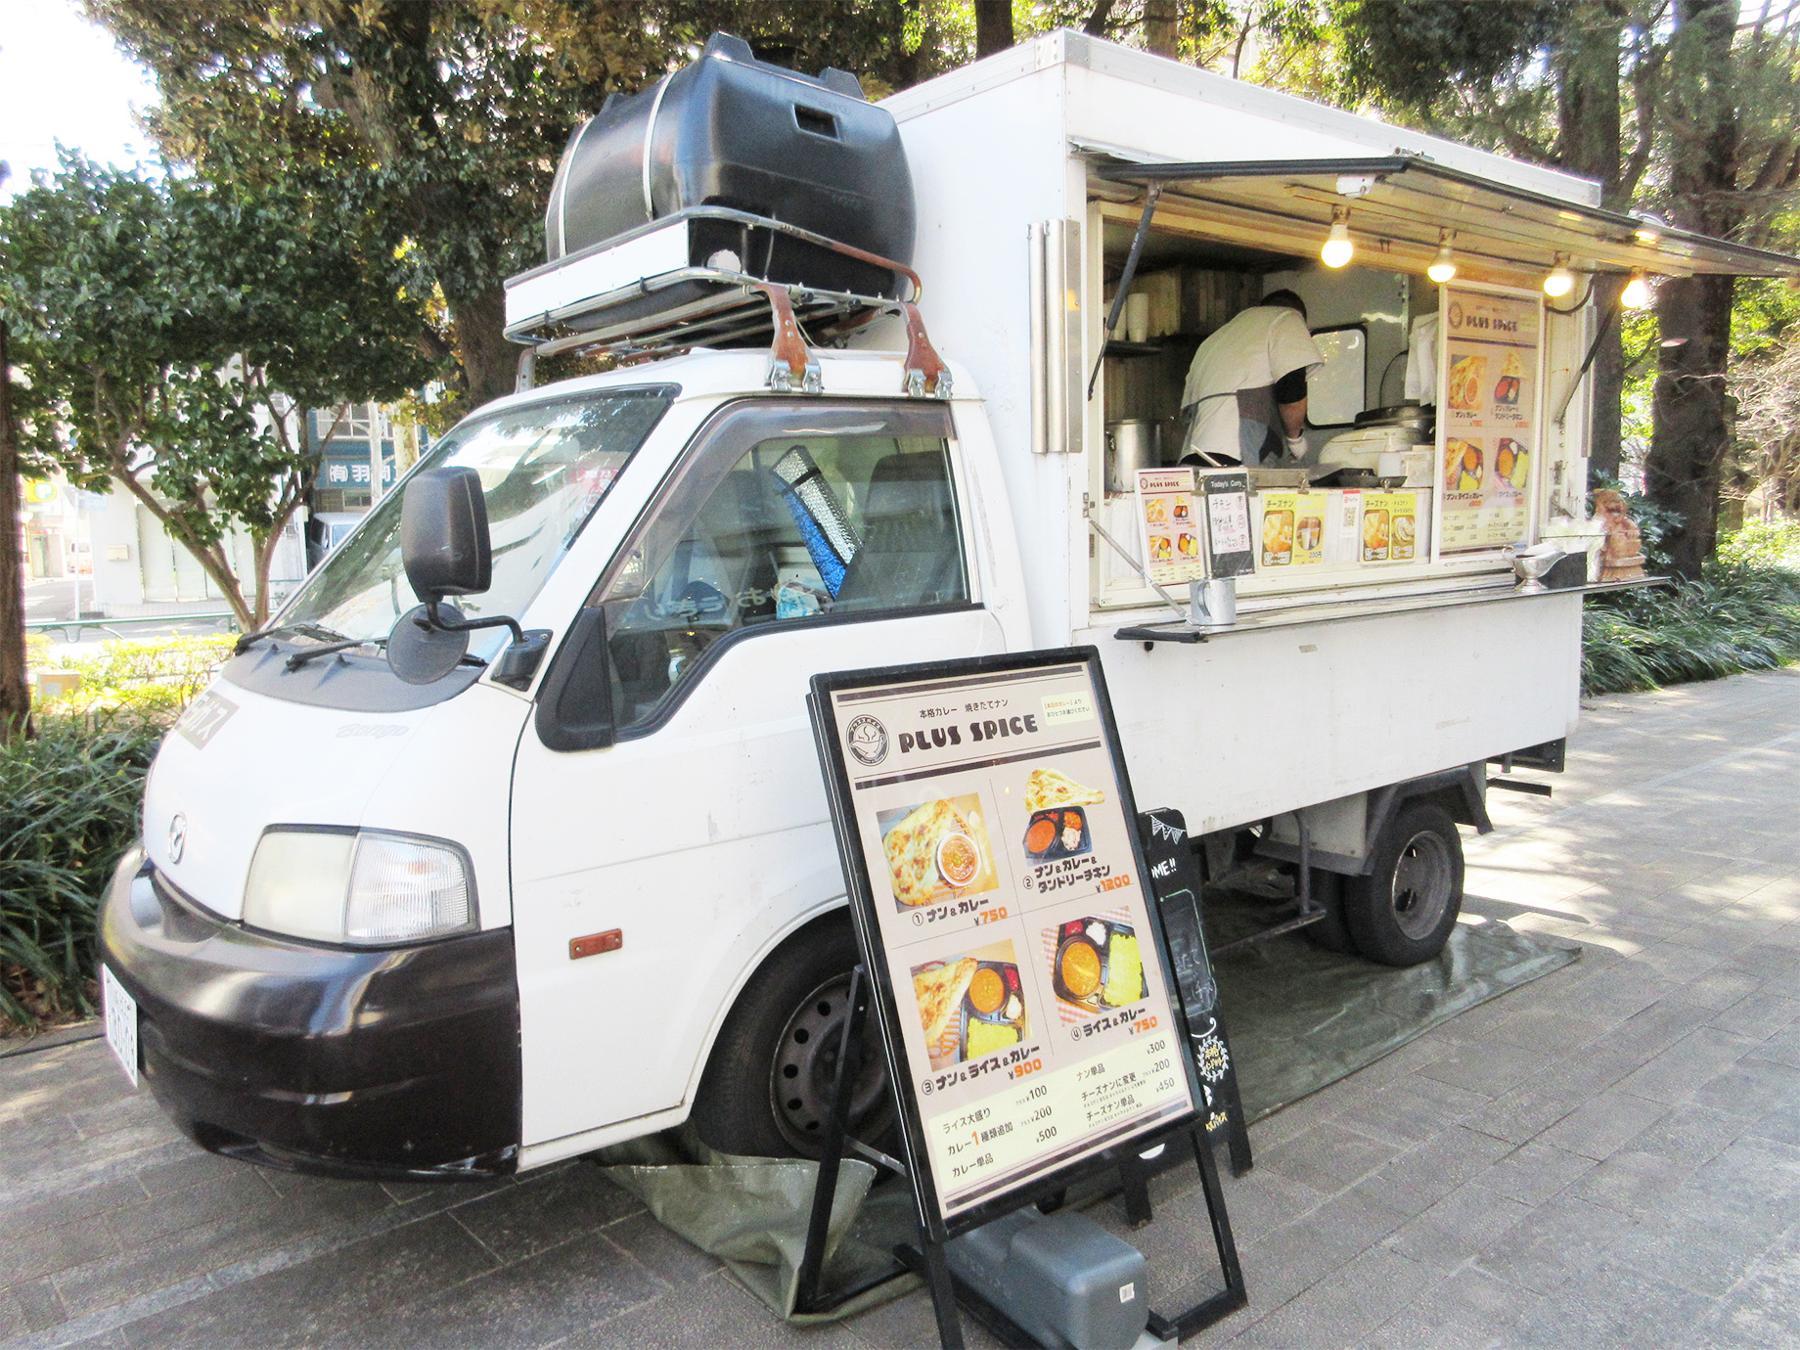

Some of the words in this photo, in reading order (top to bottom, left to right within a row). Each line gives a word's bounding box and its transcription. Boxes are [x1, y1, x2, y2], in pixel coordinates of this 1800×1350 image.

[919, 706, 958, 719] 本格カレー
[964, 699, 1009, 713] 焼きたてナン
[898, 725, 961, 753] PLUS
[969, 713, 1039, 743] SPICE
[1038, 865, 1111, 894] タンドリーチキン
[1096, 874, 1131, 893] ¥1200
[974, 906, 1008, 927] ¥750
[1128, 1016, 1158, 1036] ¥750
[1008, 1058, 1042, 1081] ¥900
[1076, 1063, 1106, 1081] ナン単品
[1146, 1039, 1166, 1055] ¥300
[1081, 1072, 1136, 1102] チーズナンに変更
[943, 1107, 991, 1135] ライス大盛り
[1086, 1094, 1135, 1121] チーズナン単品
[952, 1153, 994, 1178] カレー単品
[1035, 1126, 1057, 1143] ¥500
